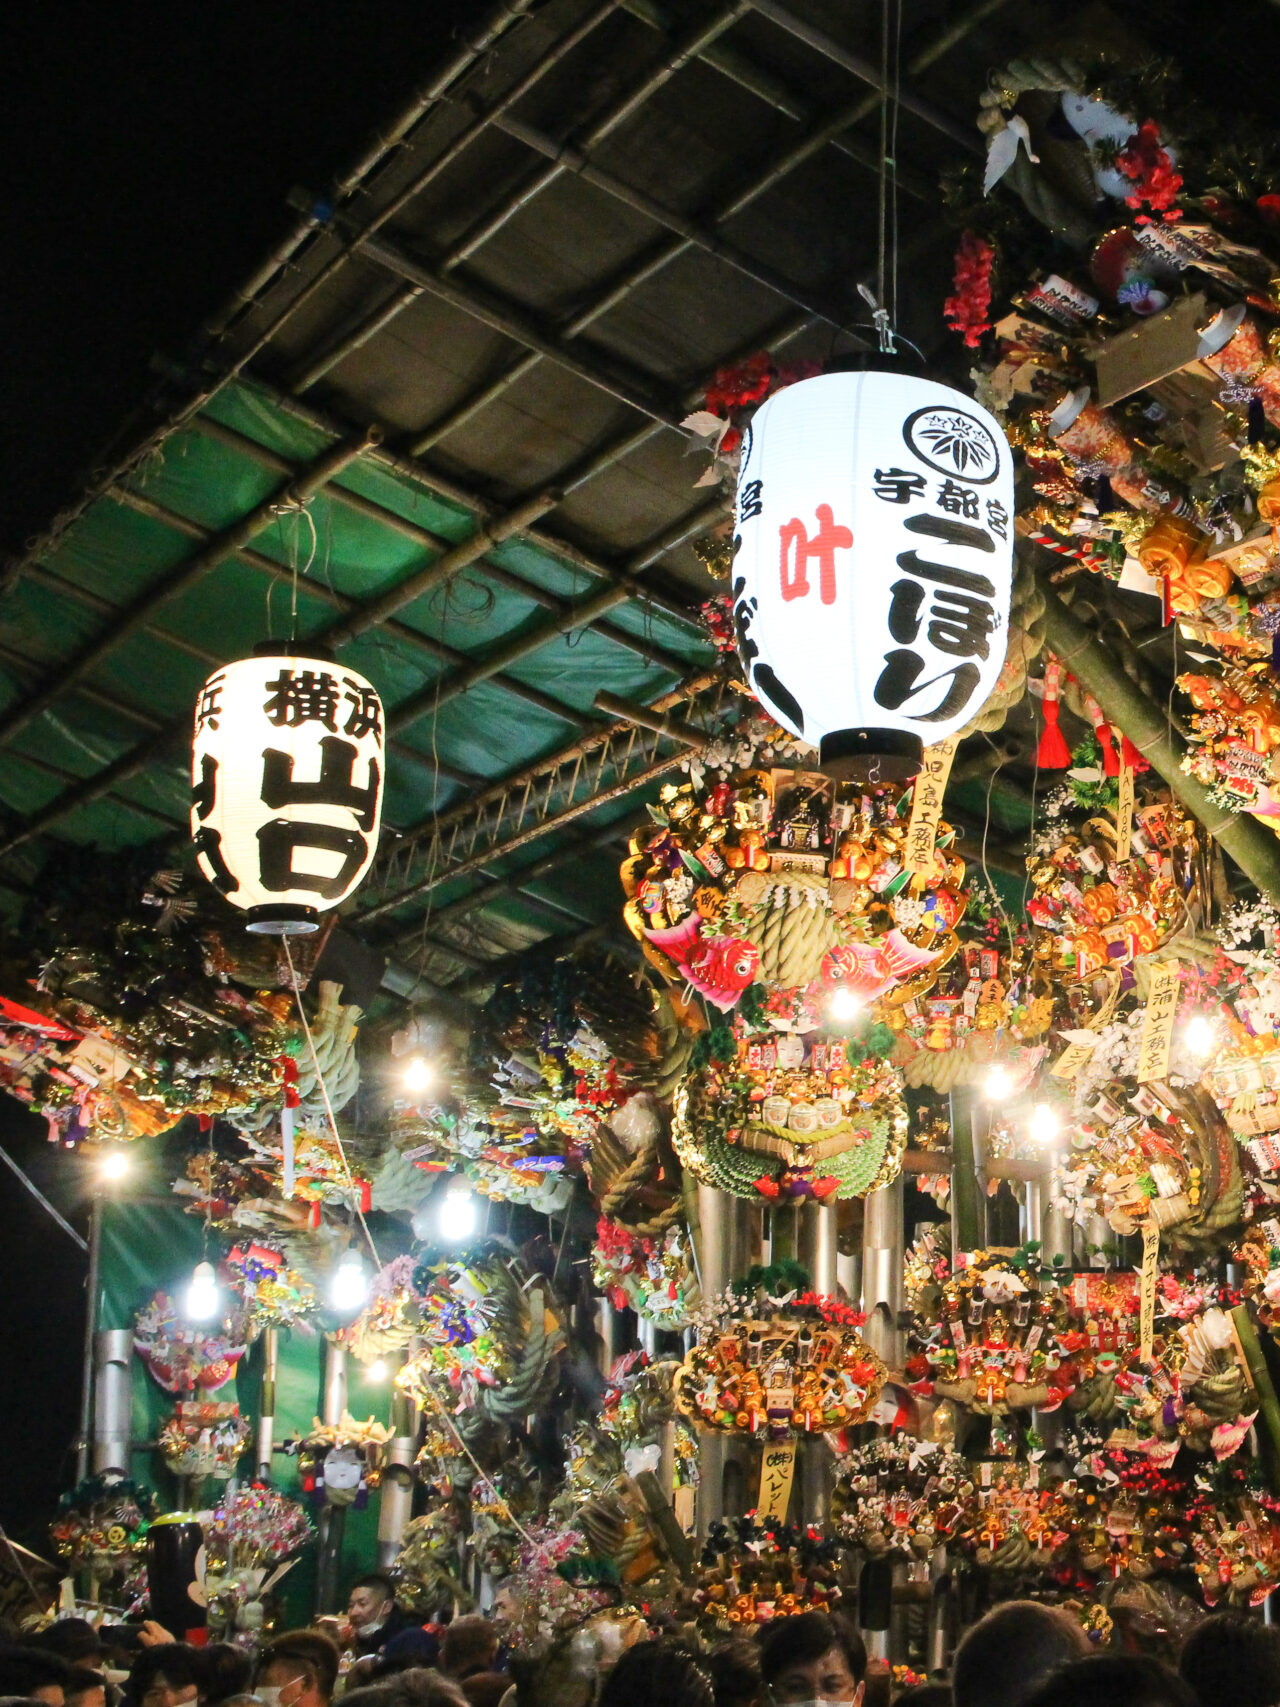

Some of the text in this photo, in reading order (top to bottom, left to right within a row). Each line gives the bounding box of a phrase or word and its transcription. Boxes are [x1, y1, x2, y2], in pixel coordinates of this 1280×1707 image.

[872, 467, 1009, 544] 宇都宮
[779, 503, 854, 605] 叶
[263, 669, 382, 750] 横浜
[256, 735, 380, 900] 山口
